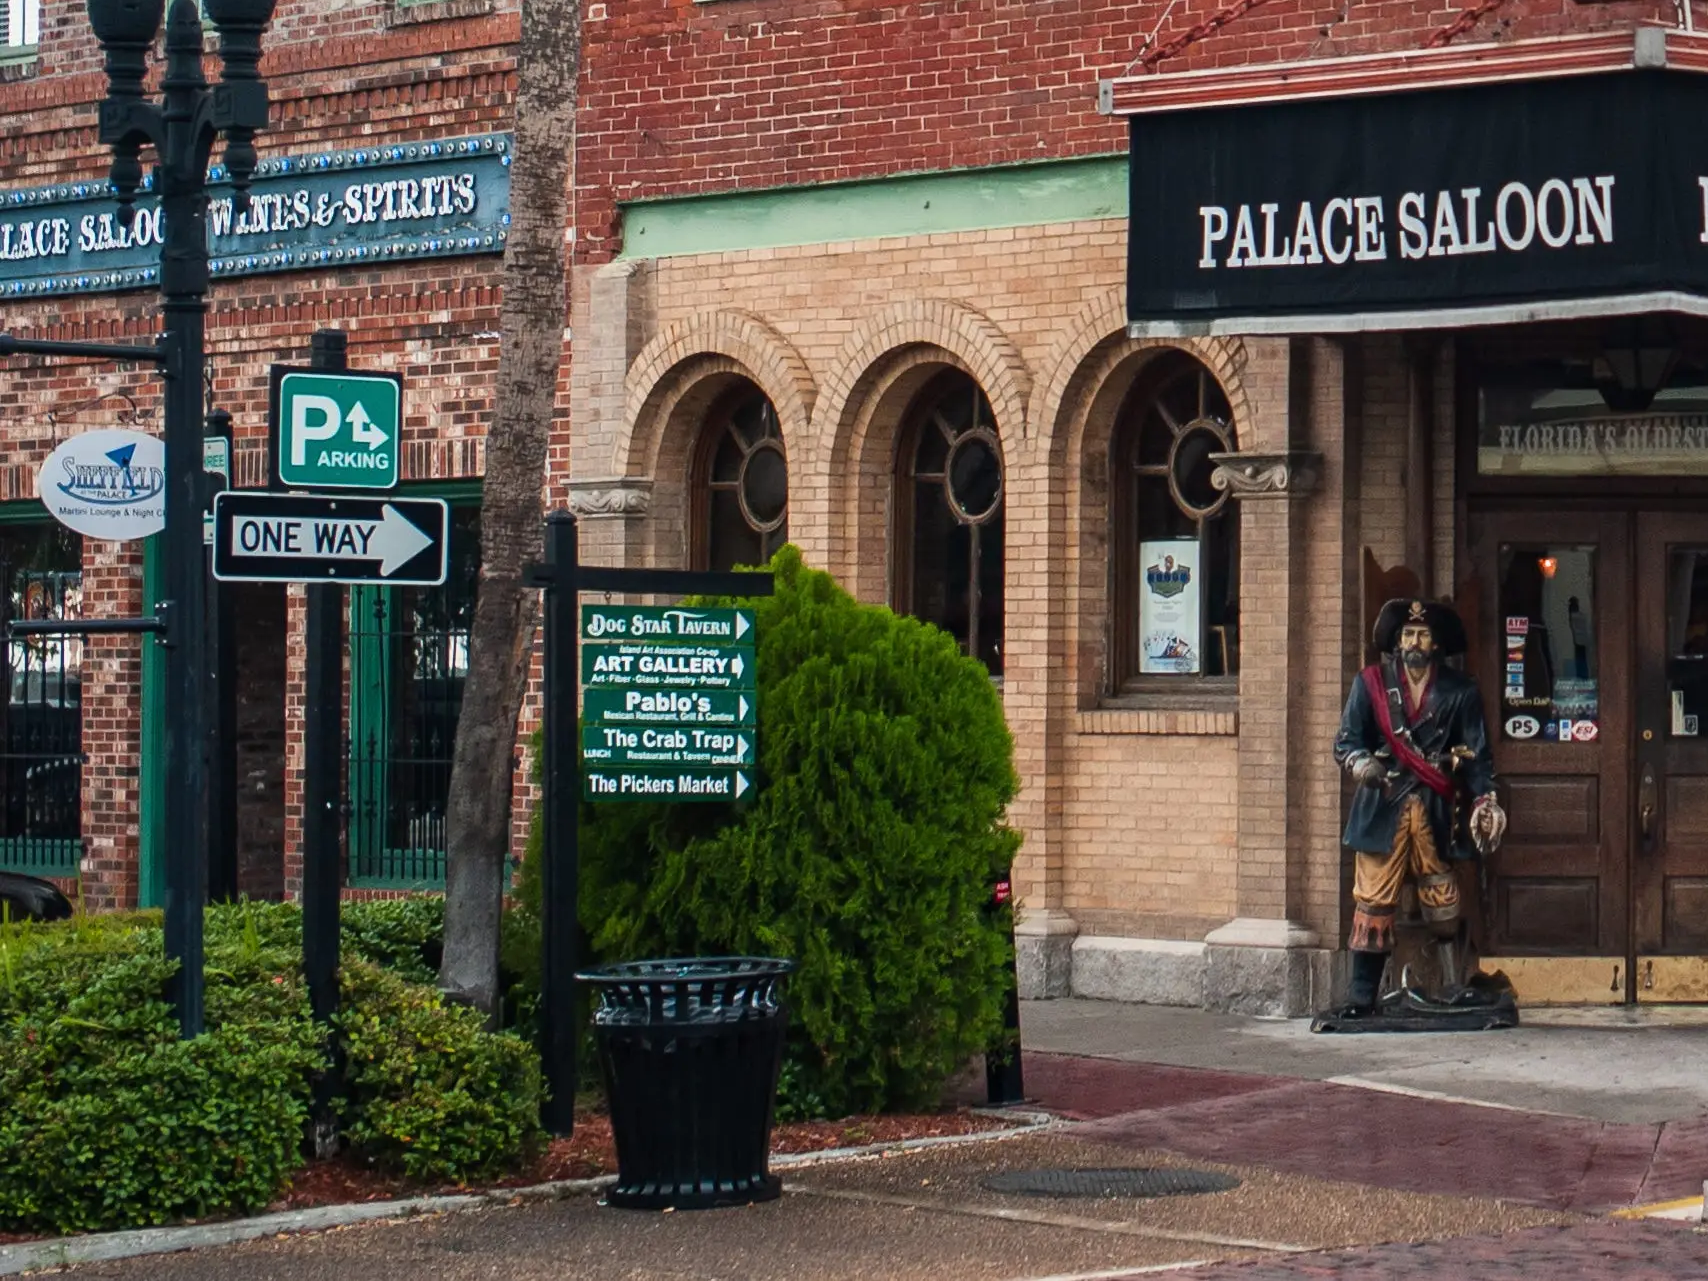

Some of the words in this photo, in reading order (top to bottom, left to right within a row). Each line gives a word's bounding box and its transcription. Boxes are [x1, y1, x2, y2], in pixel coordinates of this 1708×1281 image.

[0, 218, 70, 260] LACE
[78, 204, 164, 252] SALOO
[312, 192, 343, 226] &
[343, 173, 476, 224] SPIRITS
[1200, 195, 1386, 268] PALACE
[1398, 175, 1615, 258] SALOON
[1500, 425, 1617, 454] FLORIDA'S
[204, 454, 226, 468] REE
[57, 455, 164, 497] SHEFFIELD
[97, 490, 126, 499] PALACE
[59, 506, 87, 516] Martini
[90, 507, 121, 519] Lounge
[123, 508, 130, 516] &
[132, 509, 154, 519] Night
[240, 520, 301, 553] ONE
[313, 523, 376, 555] WAY
[587, 614, 626, 636] DOG
[631, 615, 671, 635] STAR
[663, 611, 730, 635] TAVERN
[619, 645, 641, 654] Island
[642, 646, 653, 654] Art
[654, 646, 695, 655] Association
[696, 647, 719, 657] Co-op
[593, 656, 635, 672] ART
[638, 657, 729, 673] GALLERY
[591, 674, 605, 683] Art
[626, 691, 711, 712] Pablo's
[603, 711, 634, 719] Mexican
[680, 712, 696, 720] Grill
[705, 713, 735, 722] Cantina
[1511, 720, 1533, 734] PS
[603, 728, 638, 747] The
[642, 729, 687, 748] Crab
[692, 730, 734, 752] Trap
[584, 749, 611, 758] LUNCH
[627, 750, 672, 760] Restaurant
[683, 751, 710, 760] Tavern
[588, 774, 617, 793] The
[621, 775, 675, 794] Pickers
[678, 775, 729, 794] Market
